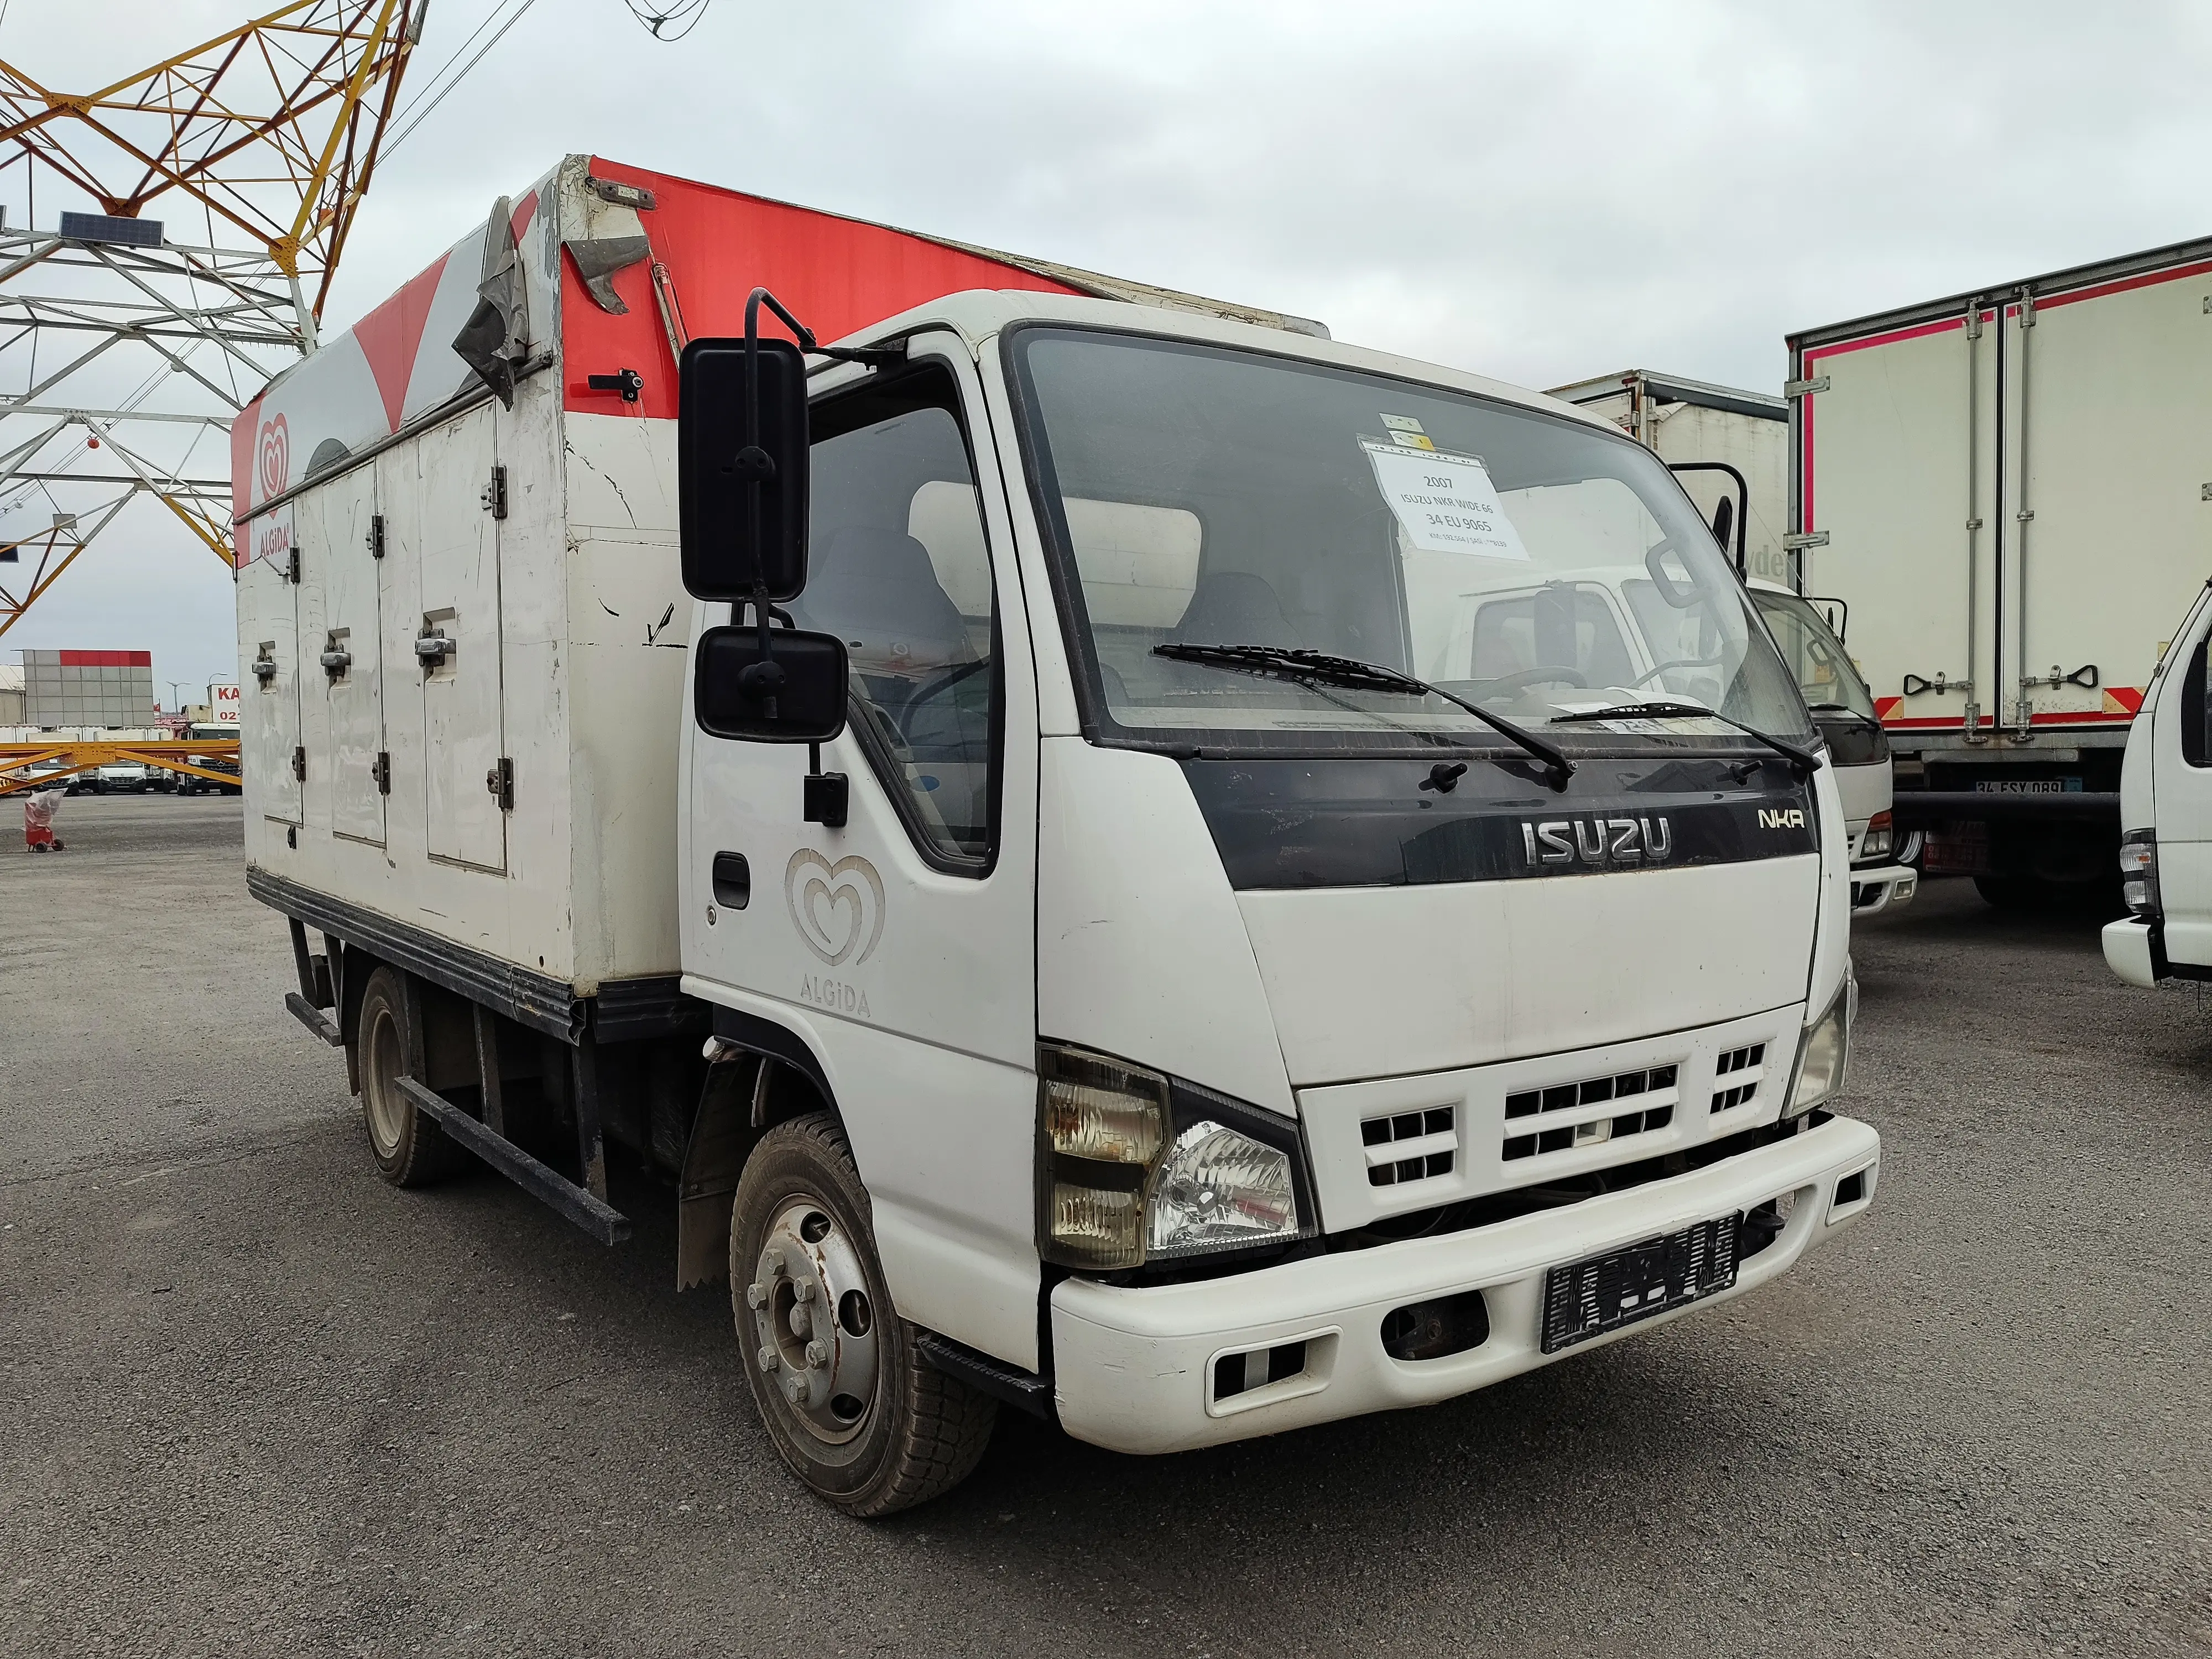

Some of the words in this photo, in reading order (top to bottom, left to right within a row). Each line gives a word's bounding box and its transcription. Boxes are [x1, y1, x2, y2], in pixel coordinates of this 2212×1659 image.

[1423, 476, 1453, 488] 2007
[1401, 494, 1432, 504] ISUZU
[1432, 497, 1455, 507] NKR
[1455, 499, 1481, 512] WIDE
[1481, 504, 1493, 513] 66
[1426, 514, 1443, 525] 34
[1444, 515, 1462, 528] EU
[1462, 518, 1492, 532] 9065
[220, 712, 240, 720] 02
[1758, 809, 1806, 829] NKR
[1521, 817, 1671, 866] ISUZU
